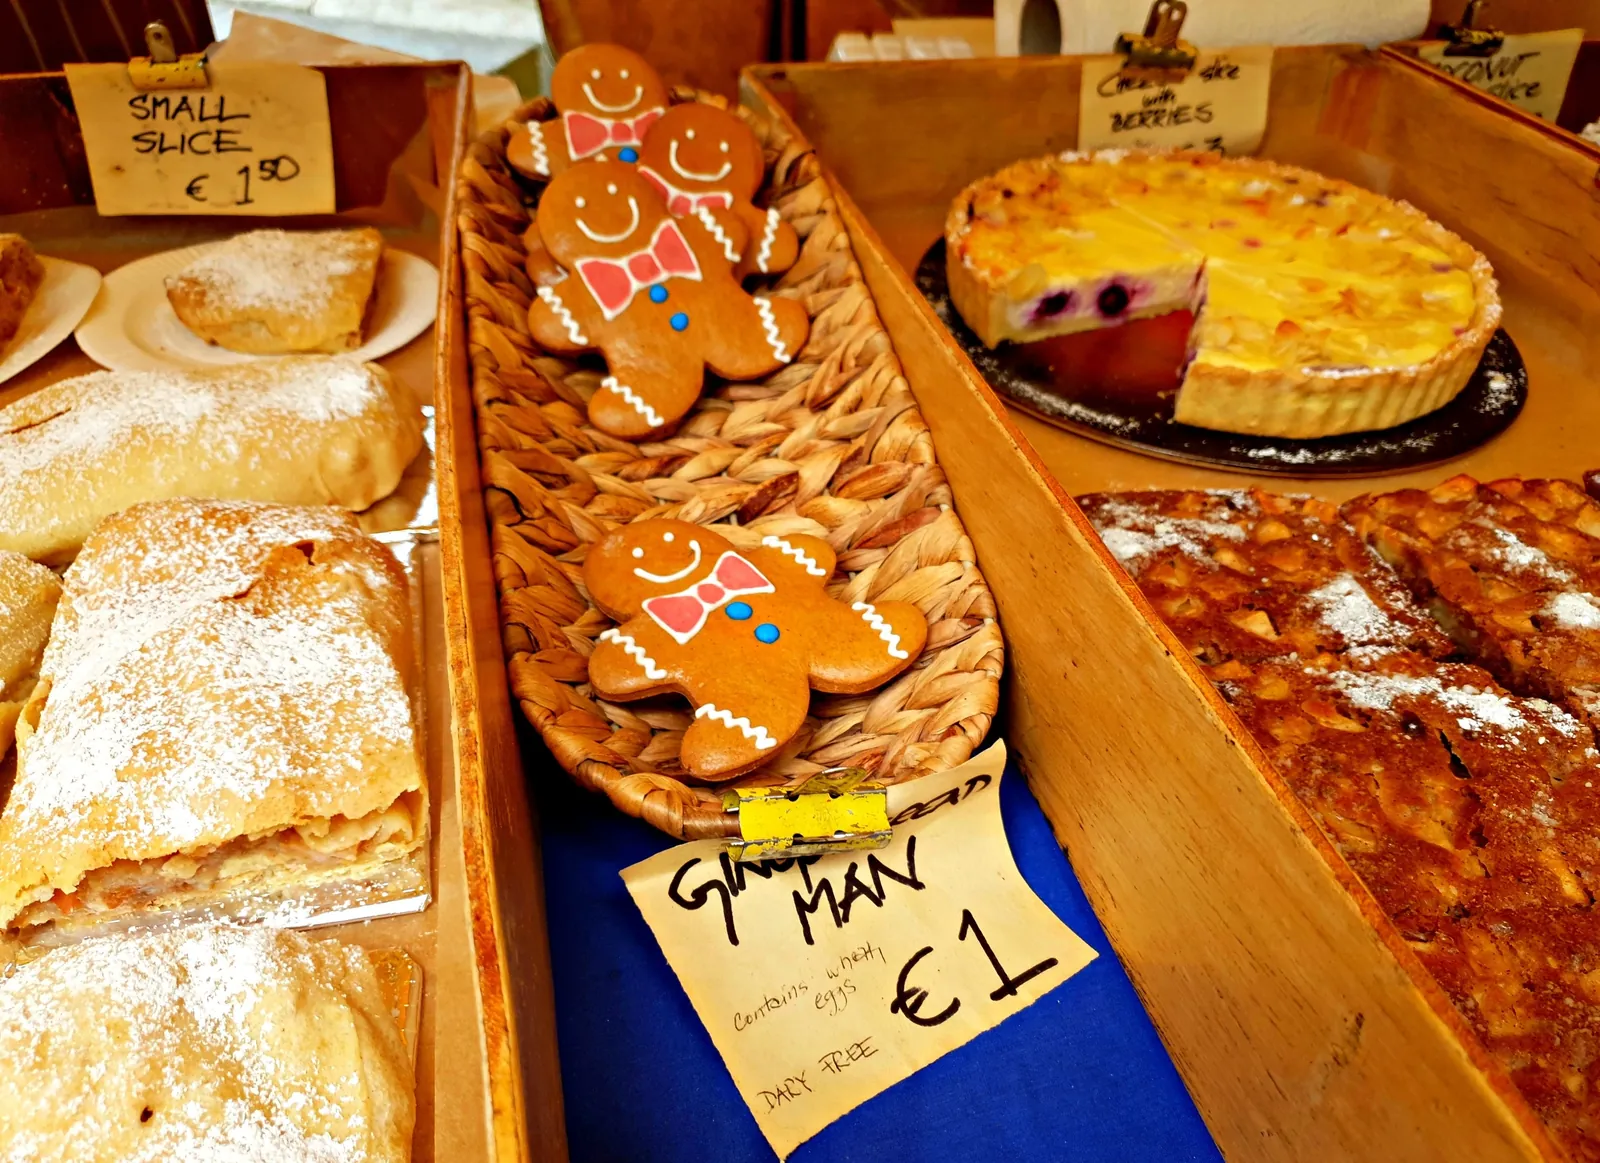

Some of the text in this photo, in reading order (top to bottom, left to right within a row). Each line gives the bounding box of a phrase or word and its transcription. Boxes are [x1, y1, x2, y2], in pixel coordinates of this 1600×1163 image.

[128, 95, 251, 123] SMALL
[1142, 87, 1175, 107] with
[1110, 103, 1213, 132] BERRIES
[131, 129, 252, 155] SLICE
[185, 174, 210, 202] €
[792, 835, 926, 946] MAN
[890, 908, 1059, 1028] € 1
[814, 978, 857, 1017] eggs
[756, 1036, 879, 1114] DARY FREE
